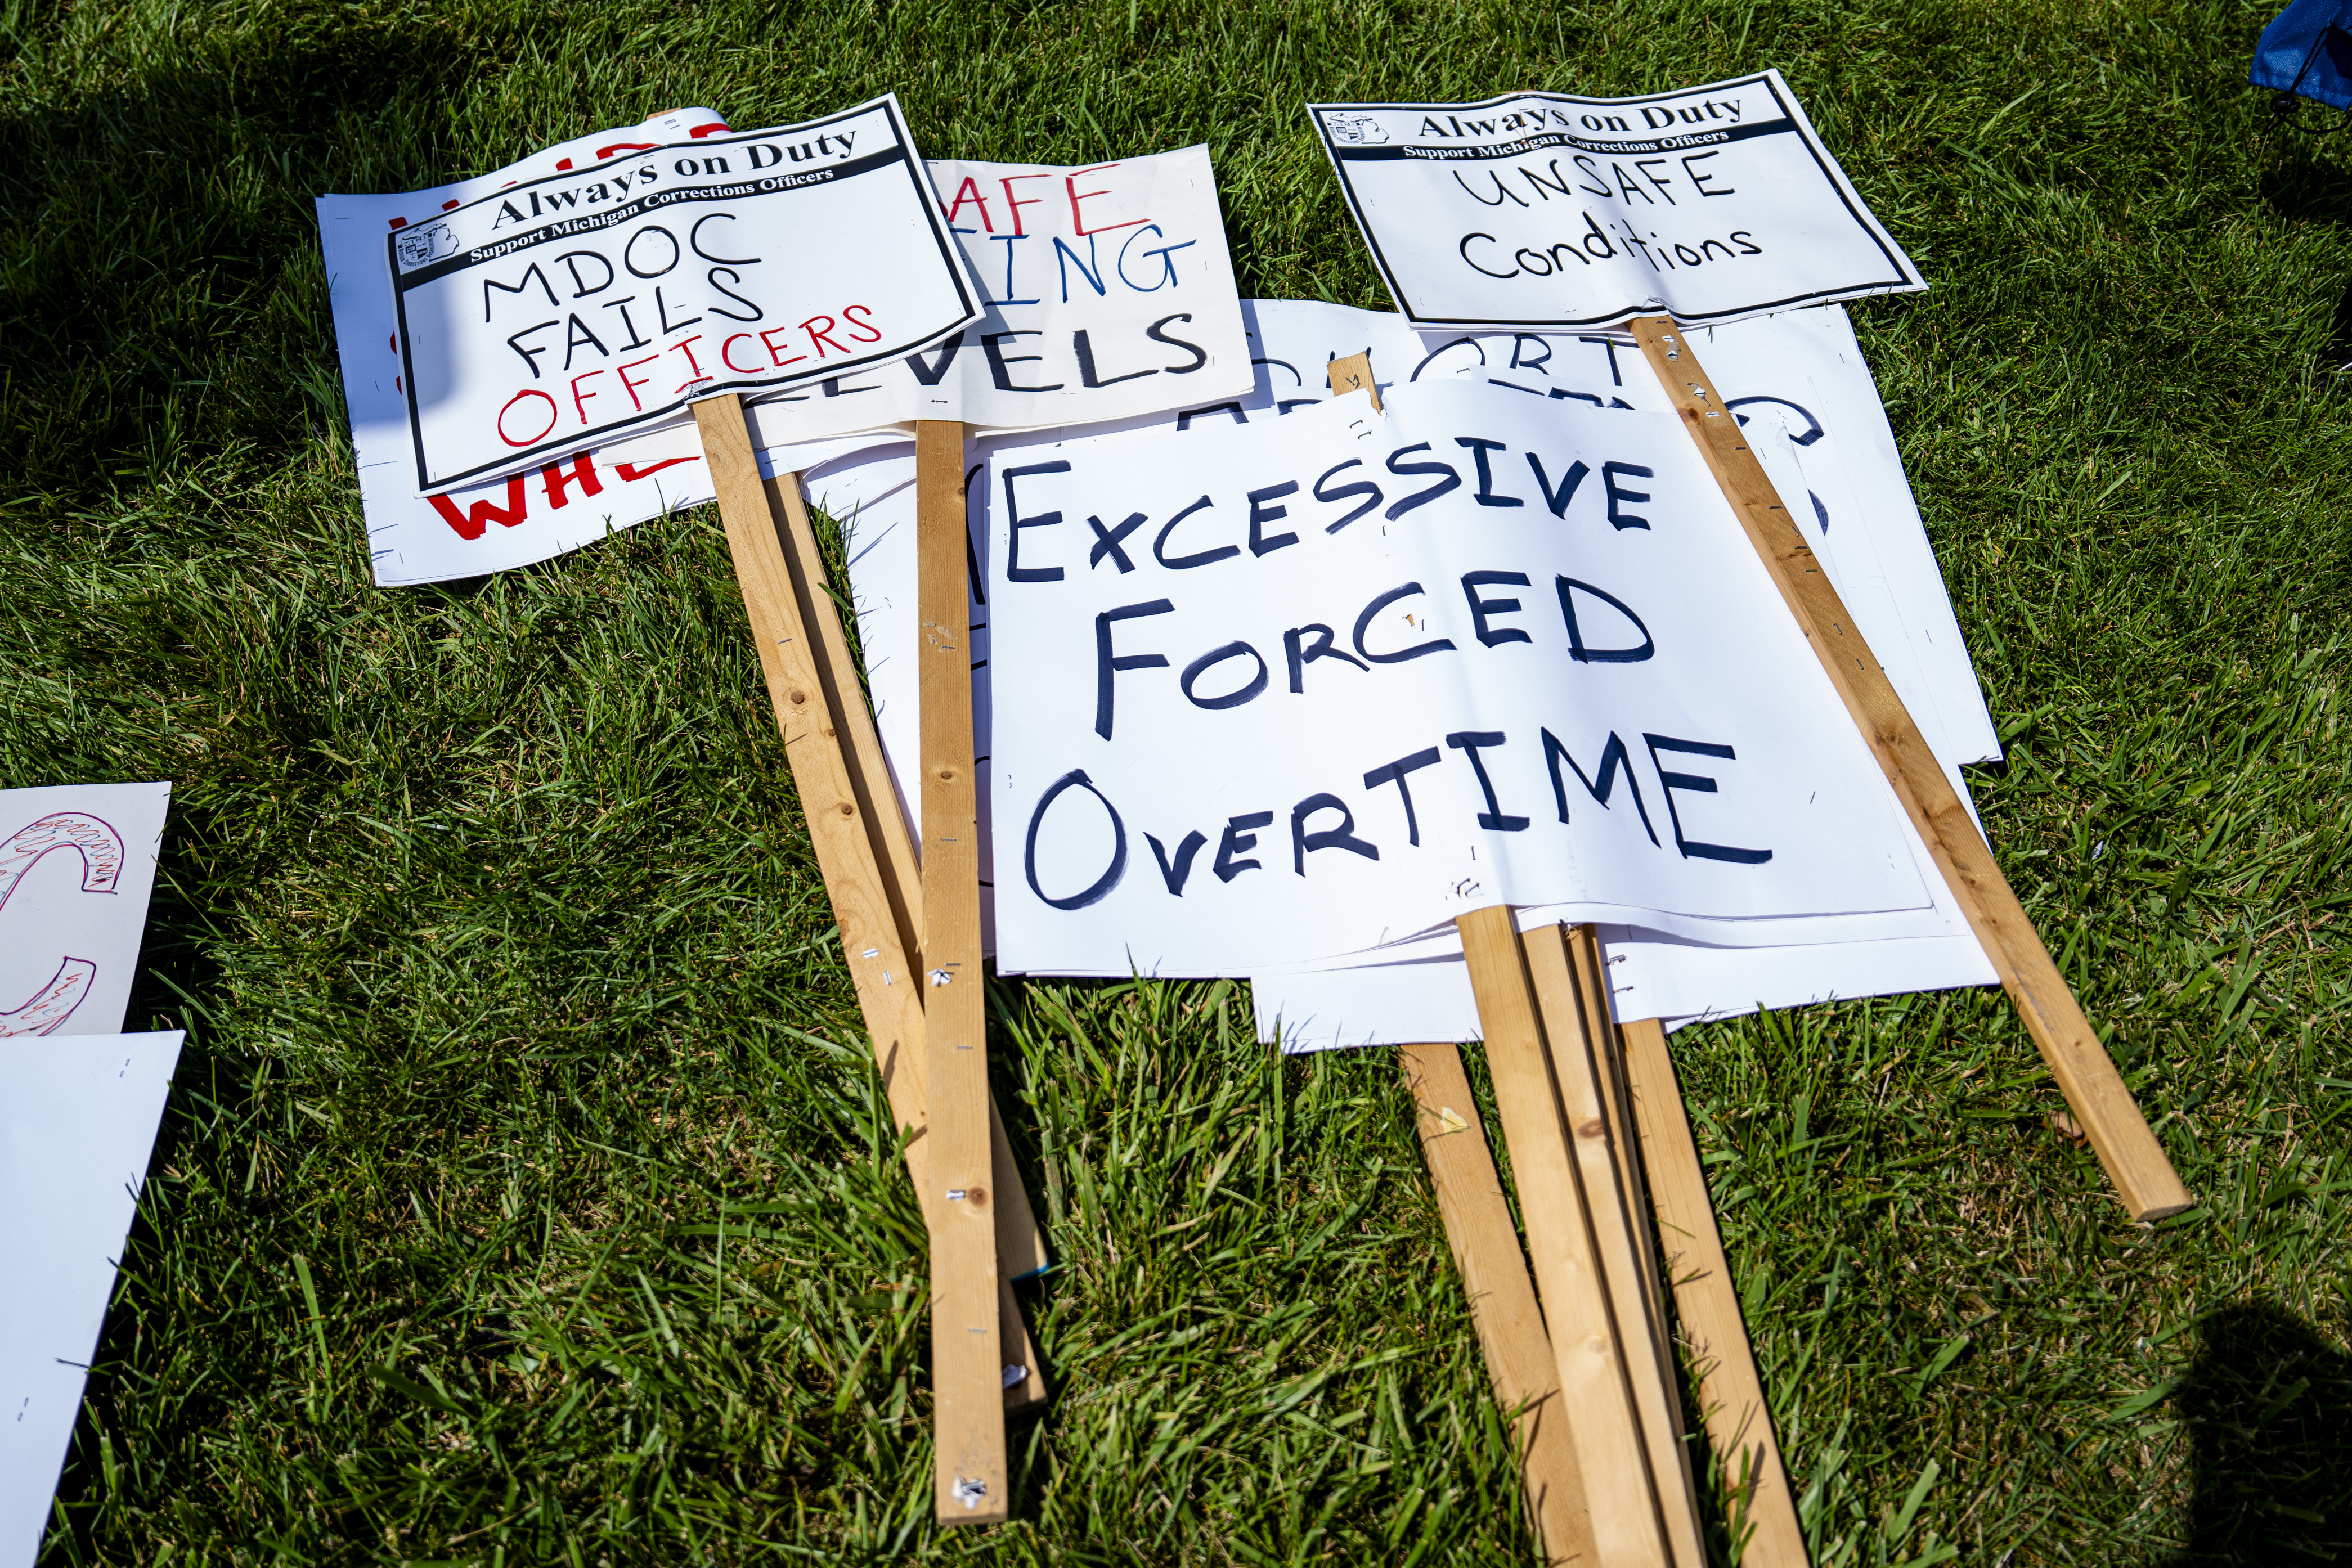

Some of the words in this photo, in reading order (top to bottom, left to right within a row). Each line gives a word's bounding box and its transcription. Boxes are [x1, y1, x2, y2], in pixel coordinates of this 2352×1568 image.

[1403, 145, 1475, 160] Support
[1478, 134, 1561, 157] Michigan
[1564, 134, 1658, 151] Corrections
[1660, 130, 1730, 149] Officers
[1419, 108, 1570, 137] Always
[1580, 114, 1632, 131] on
[1636, 98, 1741, 129] Duty
[470, 228, 546, 263] Support
[551, 204, 640, 237] Michigan
[643, 181, 755, 208] Corrections
[759, 168, 834, 191] Officers
[491, 164, 658, 231] Always
[674, 155, 733, 176] on
[742, 130, 858, 170] Duty
[936, 163, 1151, 237] AFE
[1453, 150, 1735, 207] UNSAFE
[484, 212, 762, 324] MDOC
[1459, 210, 1763, 279] Conditions
[507, 266, 764, 379] FAILS
[497, 305, 882, 447] OFFICERS
[1001, 436, 1656, 584] EXCESSIVE
[1093, 569, 1656, 743] FORCED
[1023, 725, 1774, 911] OVERTIME
